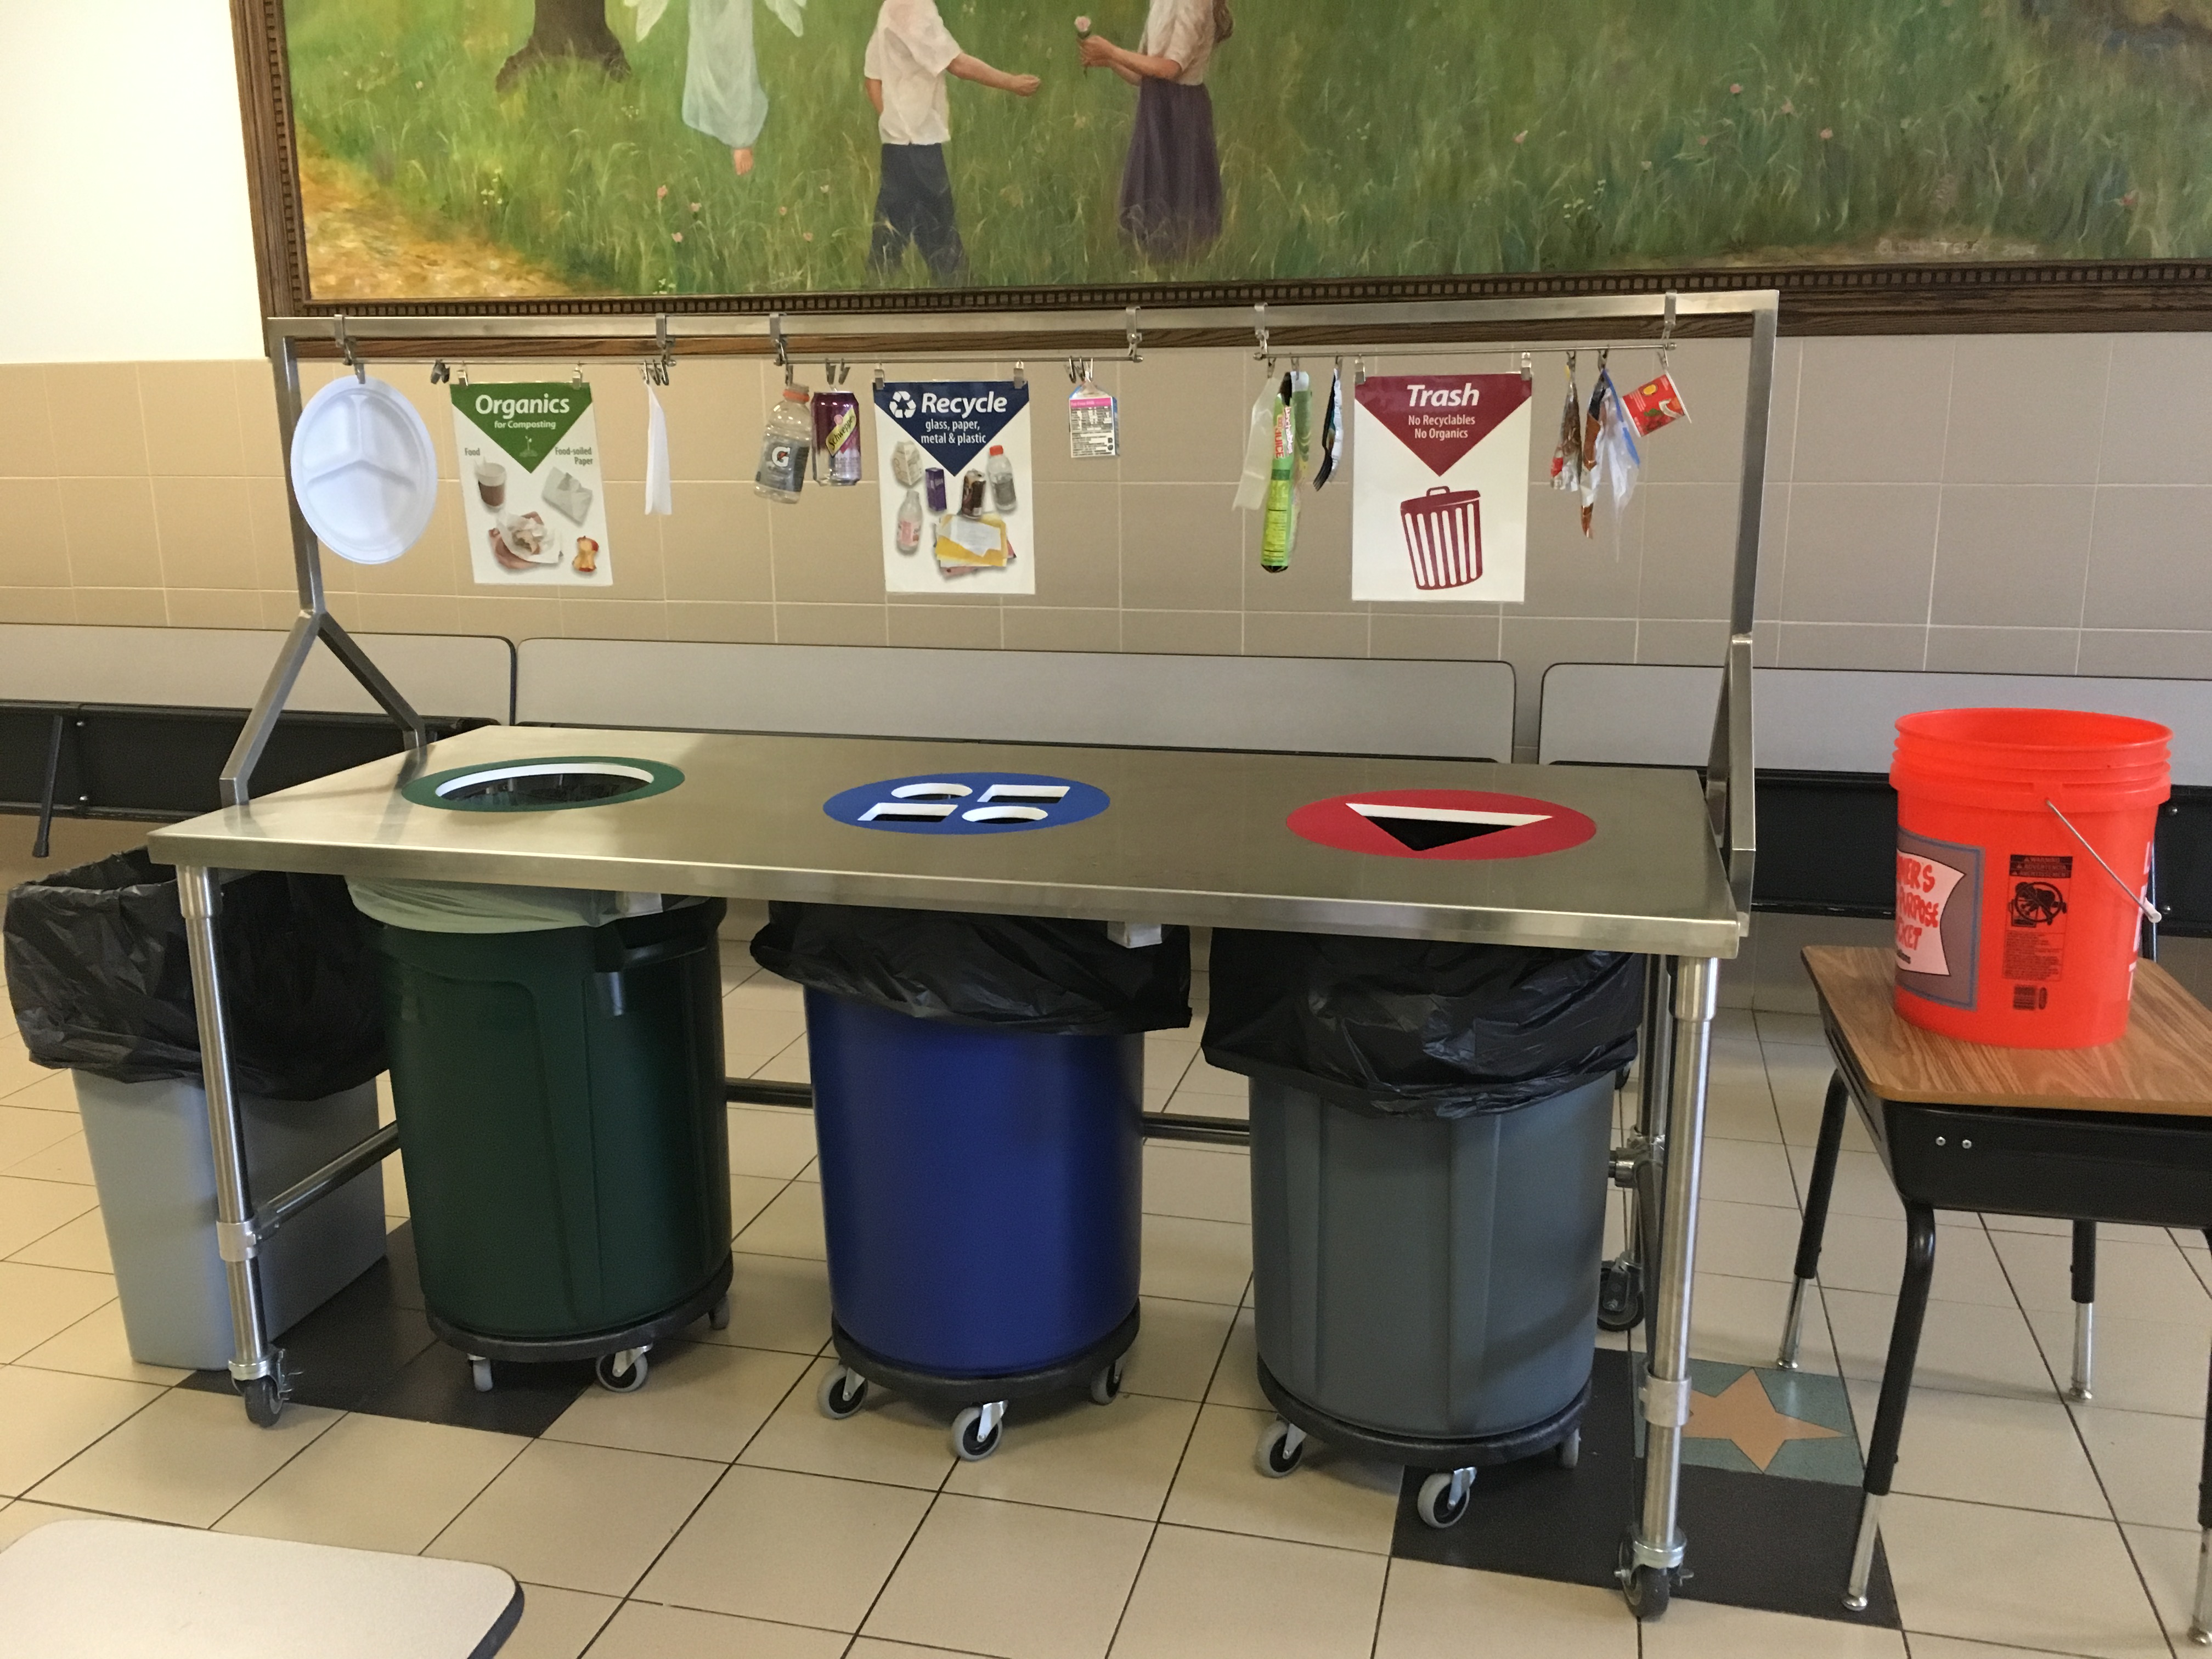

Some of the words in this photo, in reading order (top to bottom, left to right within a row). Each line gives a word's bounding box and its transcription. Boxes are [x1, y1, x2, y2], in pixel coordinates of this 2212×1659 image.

[1407, 382, 1480, 407] Trash
[475, 393, 570, 419] Organics
[921, 391, 1008, 419] Recycle
[494, 420, 506, 428] for
[507, 420, 556, 430] Composting
[925, 418, 950, 432] glass,
[952, 420, 980, 432] paper,
[1408, 415, 1421, 425] No
[1423, 414, 1476, 428] Recyclables
[921, 432, 946, 444] metal
[949, 432, 956, 444] &
[957, 432, 986, 446] plastic
[1414, 428, 1427, 438] No
[1429, 427, 1468, 441] Organics
[1275, 427, 1284, 459] JUICE
[464, 448, 481, 456] Food
[555, 447, 592, 455] Food-soiled
[771, 446, 791, 467] G
[574, 456, 594, 466] Paper
